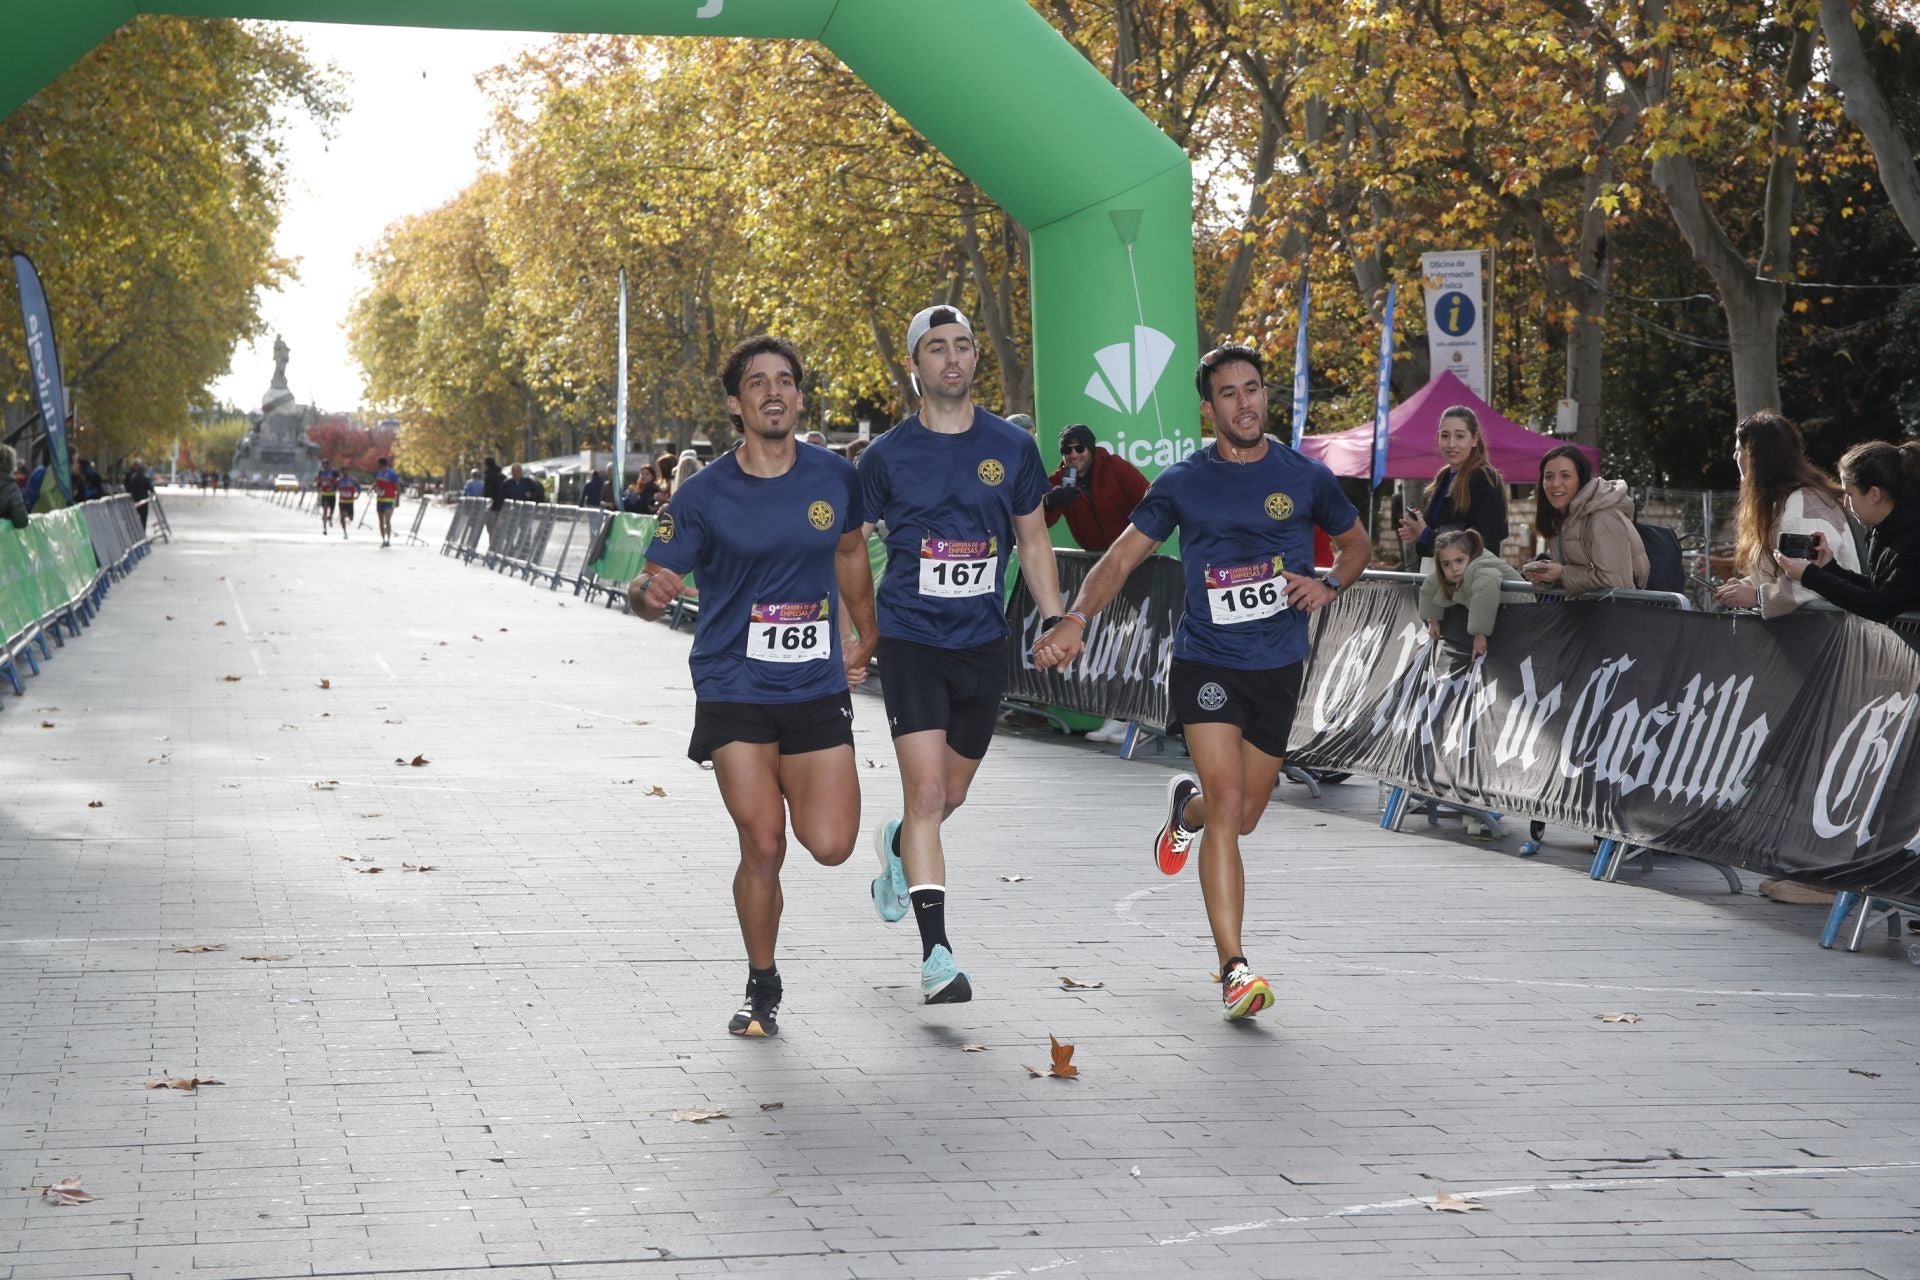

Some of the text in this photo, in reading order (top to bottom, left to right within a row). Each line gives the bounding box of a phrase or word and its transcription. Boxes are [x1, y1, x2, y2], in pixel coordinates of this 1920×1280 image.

[1456, 259, 1465, 268] de
[933, 562, 988, 586] 167
[1221, 582, 1277, 612] 166
[762, 625, 817, 650] 168
[1494, 655, 1563, 771] de
[1560, 653, 1770, 811] Castilla
